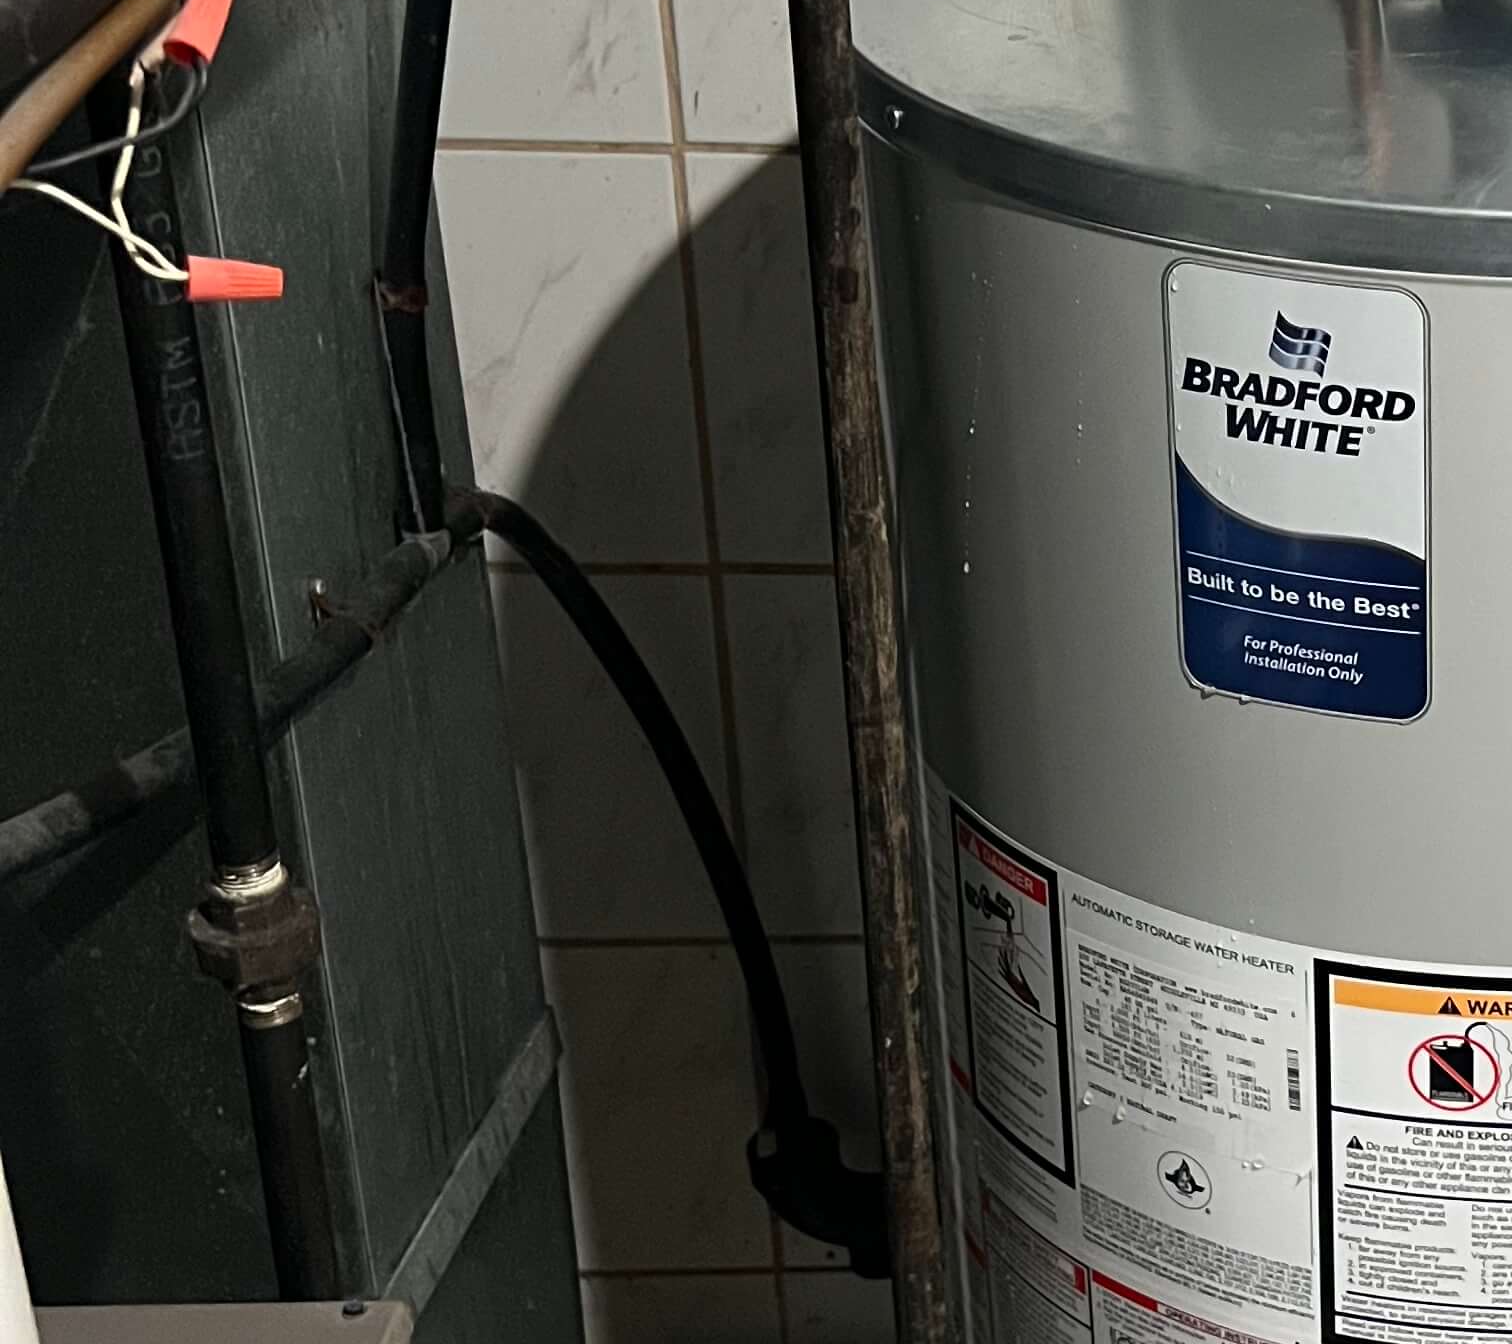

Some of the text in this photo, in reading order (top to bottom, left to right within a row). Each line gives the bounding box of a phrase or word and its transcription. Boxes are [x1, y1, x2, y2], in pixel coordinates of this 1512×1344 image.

[160, 337, 206, 461] ASTM
[1182, 357, 1416, 422] BRADFORD
[1226, 404, 1365, 457] WHITE
[1187, 567, 1411, 619] Built to be the Best
[1243, 635, 1358, 665] For Professional
[1244, 653, 1364, 686] Installation Only
[1072, 893, 1295, 975] AUTOMATIC STORAGE WATER HEATER
[1405, 1126, 1433, 1137] FIRE
[1437, 1128, 1463, 1138] AND
